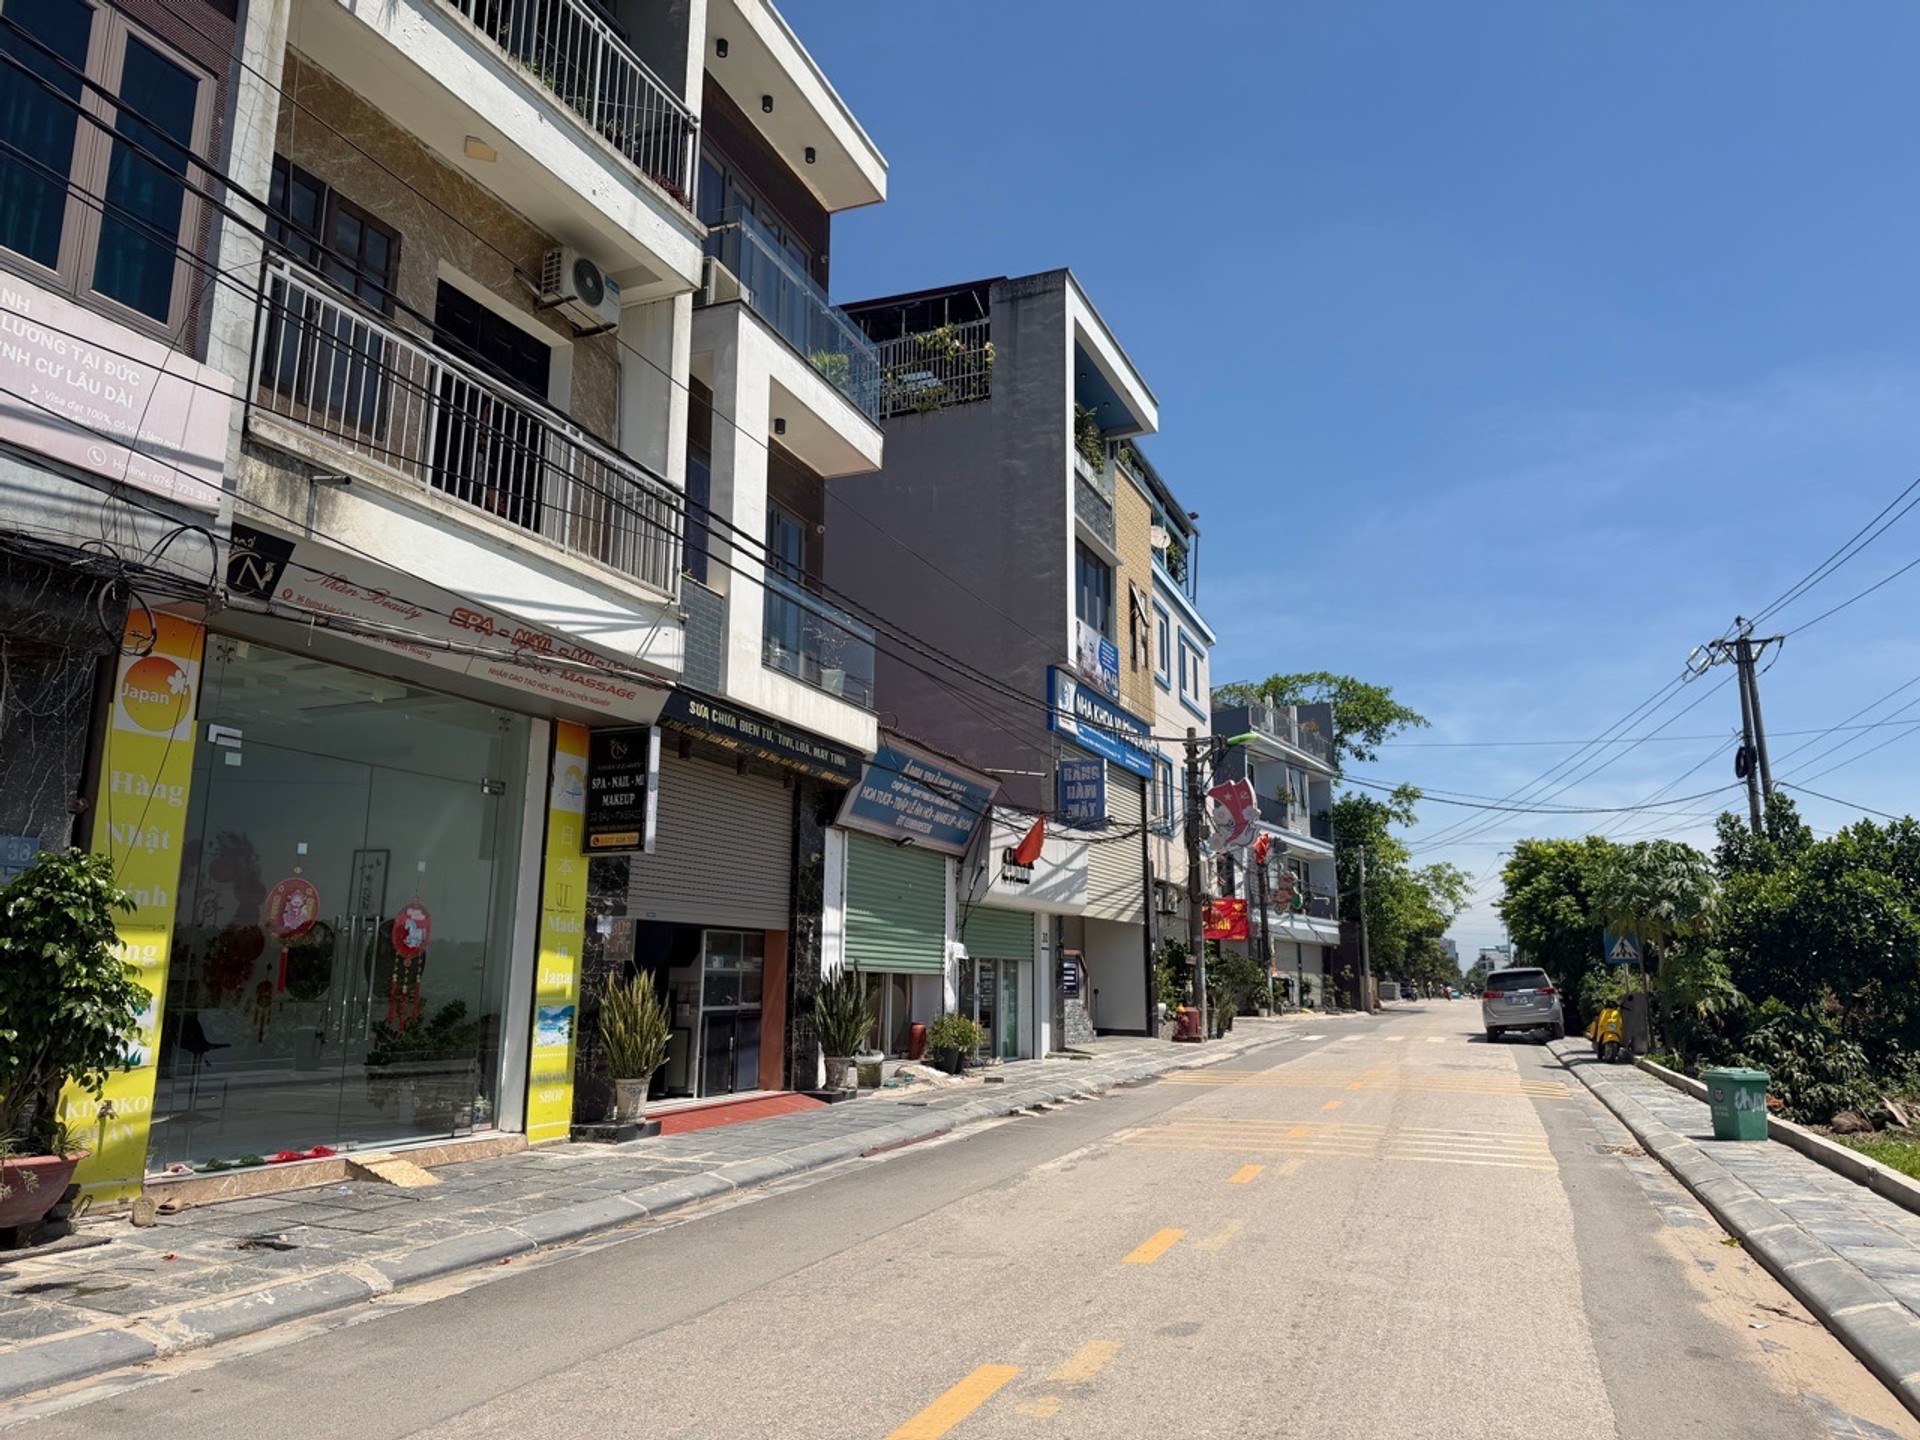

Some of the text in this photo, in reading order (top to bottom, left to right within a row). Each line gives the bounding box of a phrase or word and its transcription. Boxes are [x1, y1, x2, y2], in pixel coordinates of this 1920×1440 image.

[1, 314, 141, 386] LƯƠNG TẠI ĐỨC
[35, 357, 64, 378] CƯ
[66, 369, 101, 394] LÂU
[449, 607, 494, 636] SPA
[122, 682, 170, 705] Japan
[559, 669, 637, 700] MASSAGE
[1076, 693, 1093, 720] NHA
[1093, 704, 1114, 730] KHOA
[591, 778, 607, 790] SPA
[612, 775, 631, 789] NAIL
[1063, 763, 1100, 781] RĂNG
[110, 770, 185, 808] Hàng
[602, 793, 636, 807] MAKEUP
[1067, 782, 1096, 799] HÀM
[104, 820, 171, 854] Nhật
[548, 914, 581, 933] Made
[555, 942, 568, 958] in
[542, 967, 577, 990] Japan
[538, 1088, 565, 1104] SHOP
